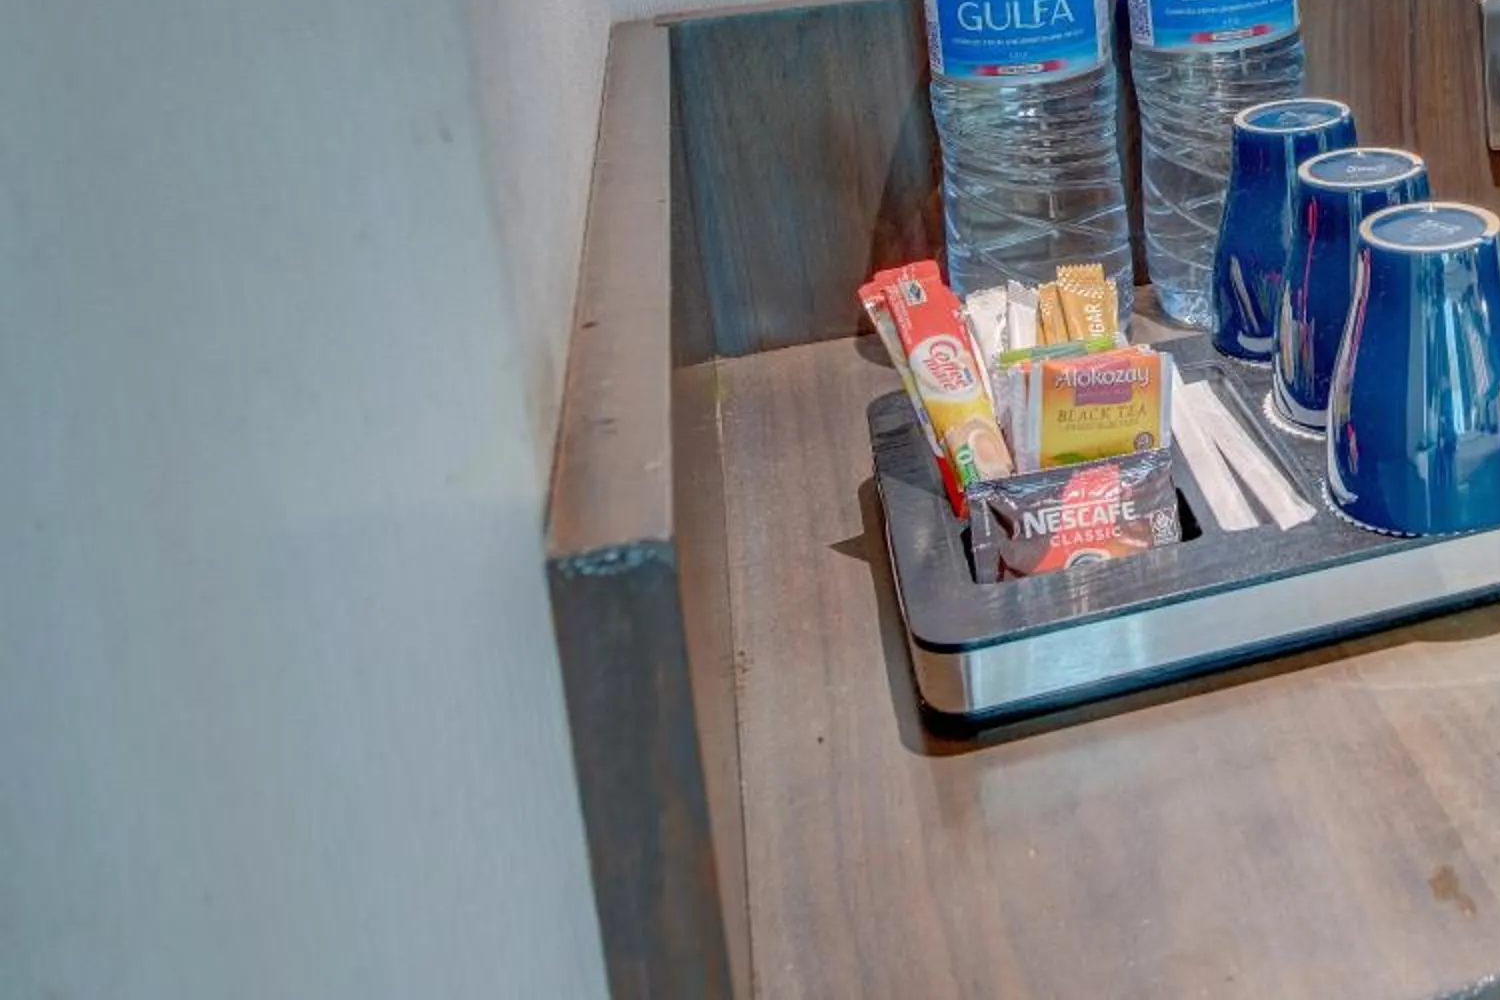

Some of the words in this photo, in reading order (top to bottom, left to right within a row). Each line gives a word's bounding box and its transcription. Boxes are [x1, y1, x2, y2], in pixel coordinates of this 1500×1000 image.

[1055, 367, 1150, 389] Alokozay
[1057, 408, 1111, 423] BLACK
[1118, 403, 1148, 417] TEA
[1050, 525, 1122, 547] CLASSIC
